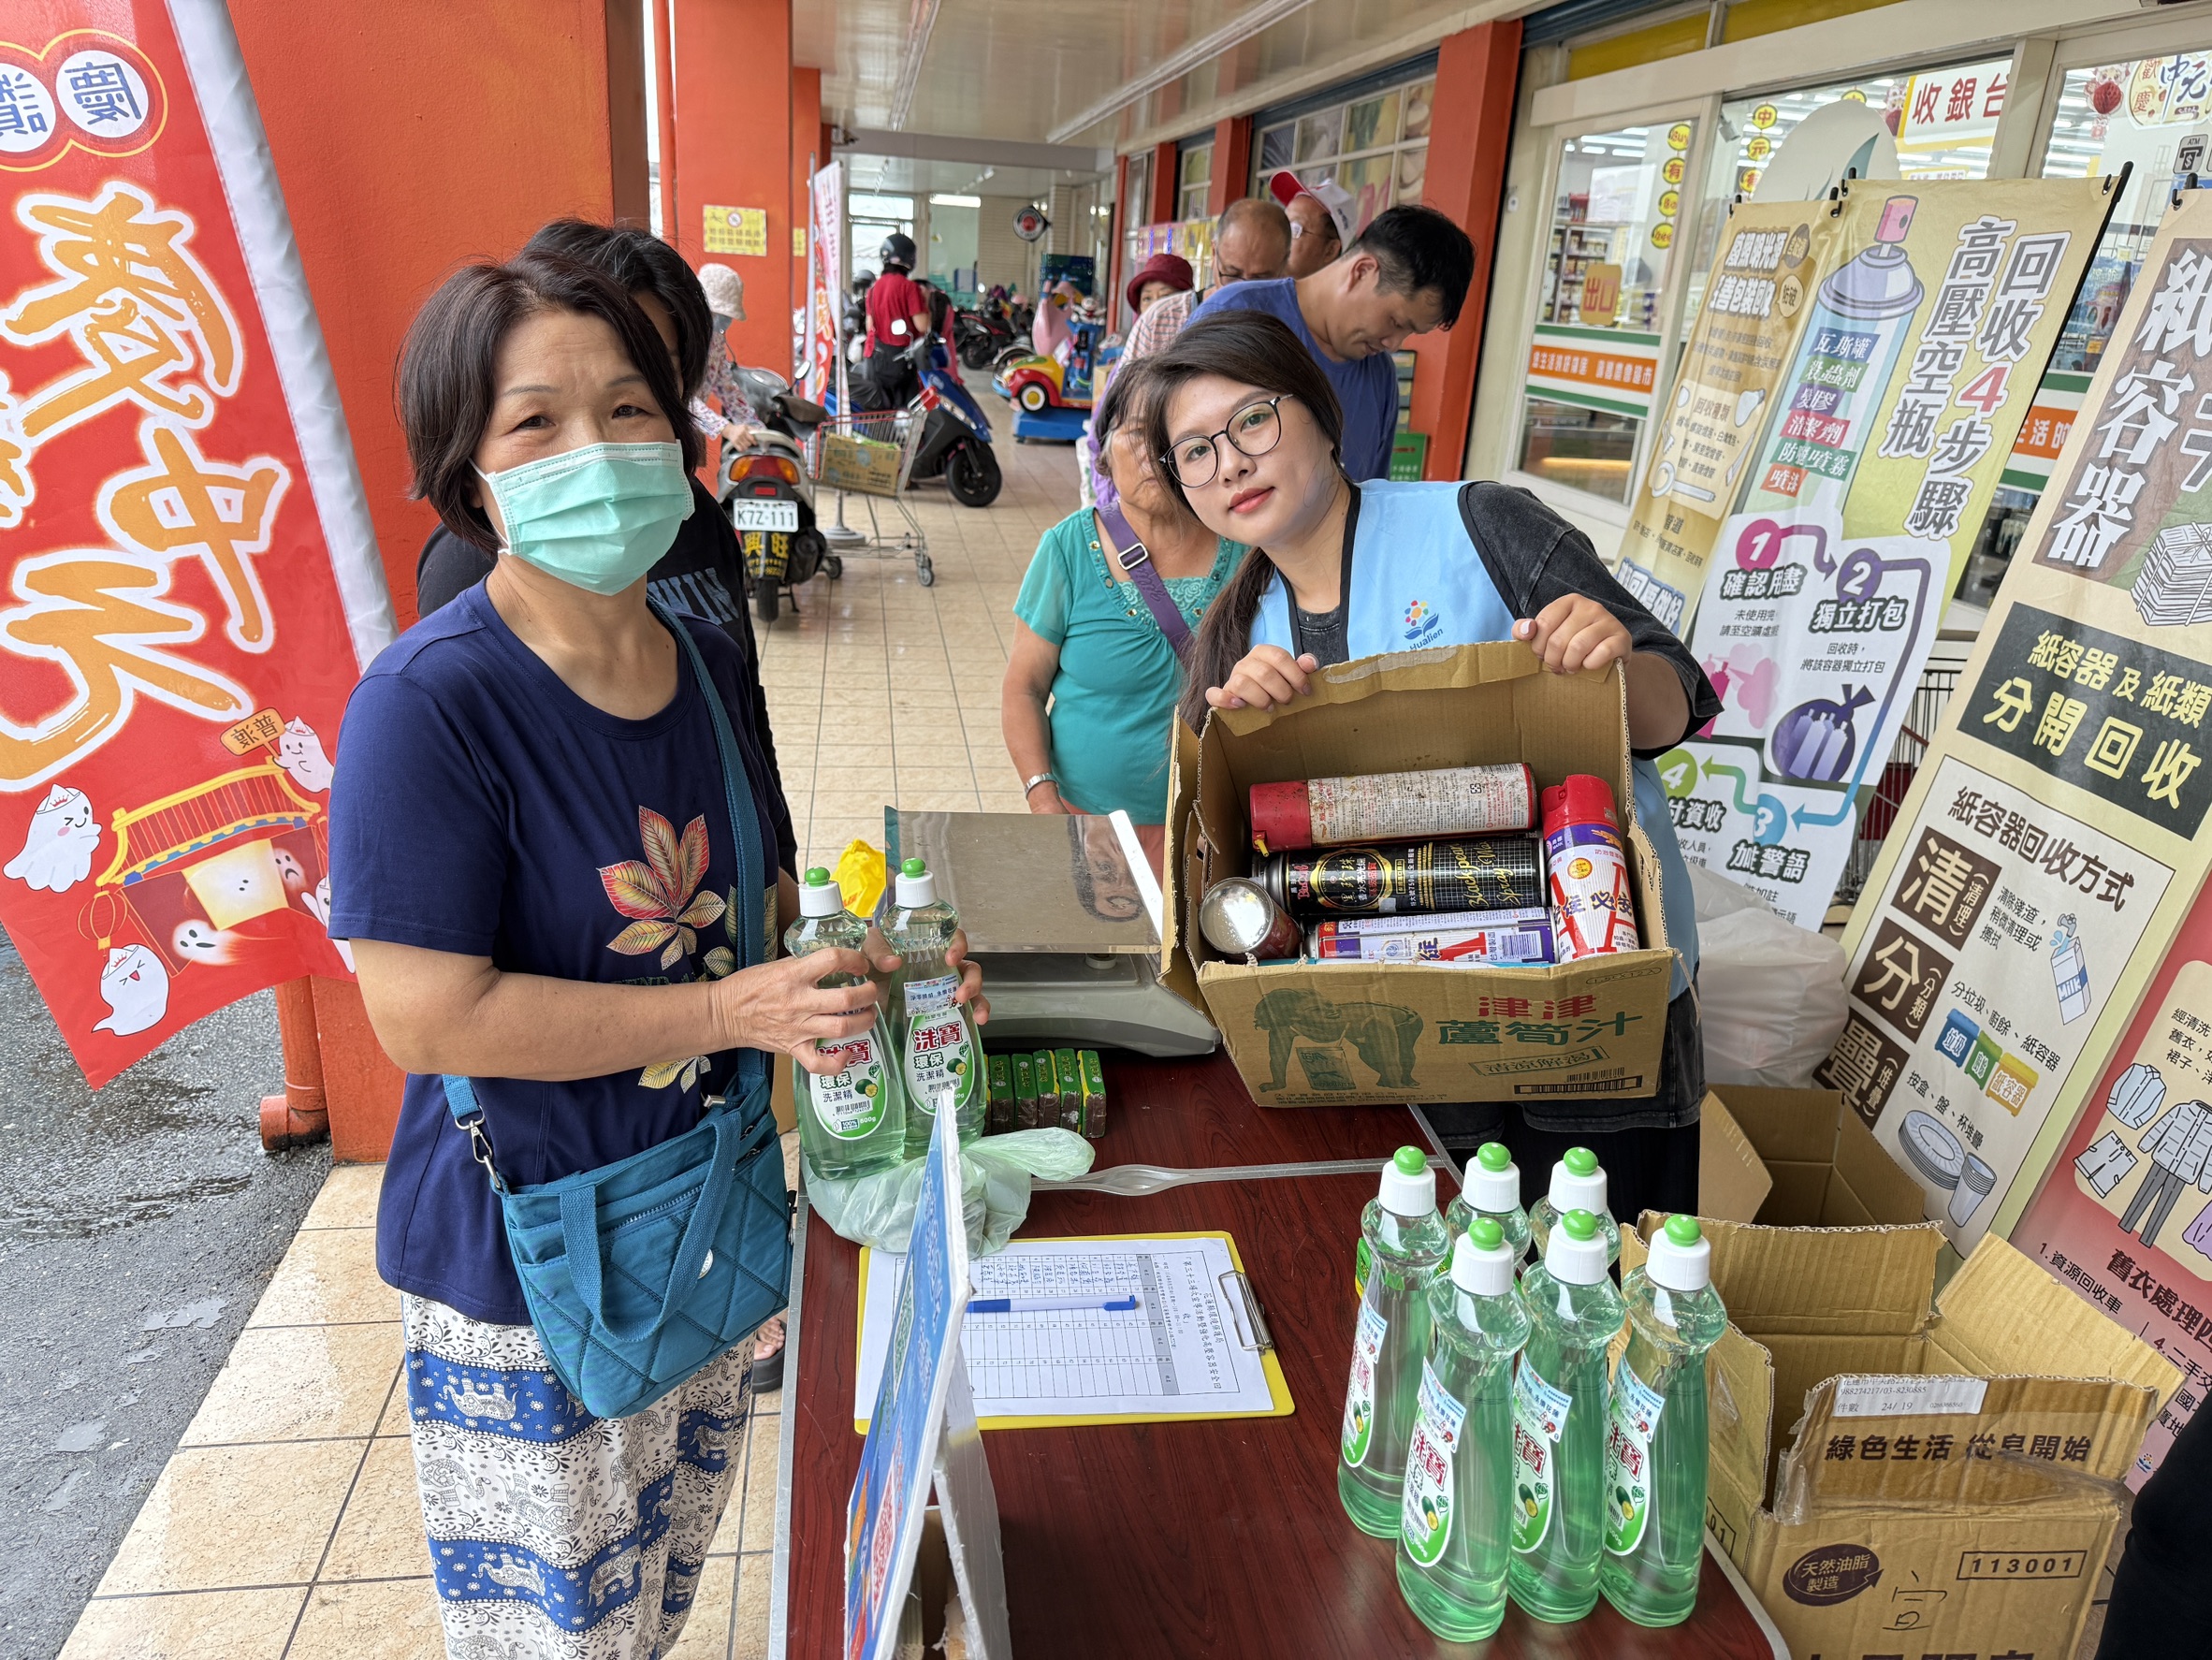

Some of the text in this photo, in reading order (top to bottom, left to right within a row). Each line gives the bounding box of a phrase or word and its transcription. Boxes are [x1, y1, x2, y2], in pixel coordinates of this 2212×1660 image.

[1912, 72, 2009, 125] 收銀台
[2187, 138, 2201, 146] ATM
[1584, 276, 1619, 313] 出口
[1813, 332, 1872, 359] 瓦斯罐
[1882, 221, 2014, 456] 高壓空瓶
[1797, 387, 1838, 413] 髮膠
[1909, 236, 2066, 536] 回收4步驟
[2047, 247, 2212, 569] 紙容器
[1787, 414, 1847, 445] 清潔劑
[1842, 561, 1871, 596] 2
[1811, 600, 1906, 632] 獨立打包
[1409, 628, 1444, 650] Hualien
[1982, 676, 2203, 809] 分開回收
[1661, 763, 1688, 790] 4
[1947, 785, 2135, 913] 紙容器回收方式
[1454, 872, 1491, 910] Black
[1492, 866, 1523, 906] Spray
[1901, 837, 1973, 926] 清
[1979, 924, 2003, 951] 擦拭
[1863, 935, 1921, 1012] 分
[1477, 994, 1597, 1021] 津津
[2170, 1007, 2212, 1038] 經清洗
[913, 1021, 963, 1053] 洗寶
[1435, 1011, 1644, 1047] 蘆筍汁
[1942, 1027, 1968, 1058] 垃圾
[914, 1052, 944, 1070] 環保
[916, 1069, 945, 1083] 洗潔精
[1822, 1018, 1884, 1107] 疊
[820, 1071, 852, 1089] 環保
[1992, 1071, 2028, 1108] 紙容器
[822, 1089, 853, 1103] 洗潔精
[1825, 1433, 2092, 1463] 綠色生活 從皂開始
[1800, 1553, 1871, 1579] 天然油脂
[1972, 1557, 2073, 1574] 113001
[1807, 1576, 1841, 1594] 製造
